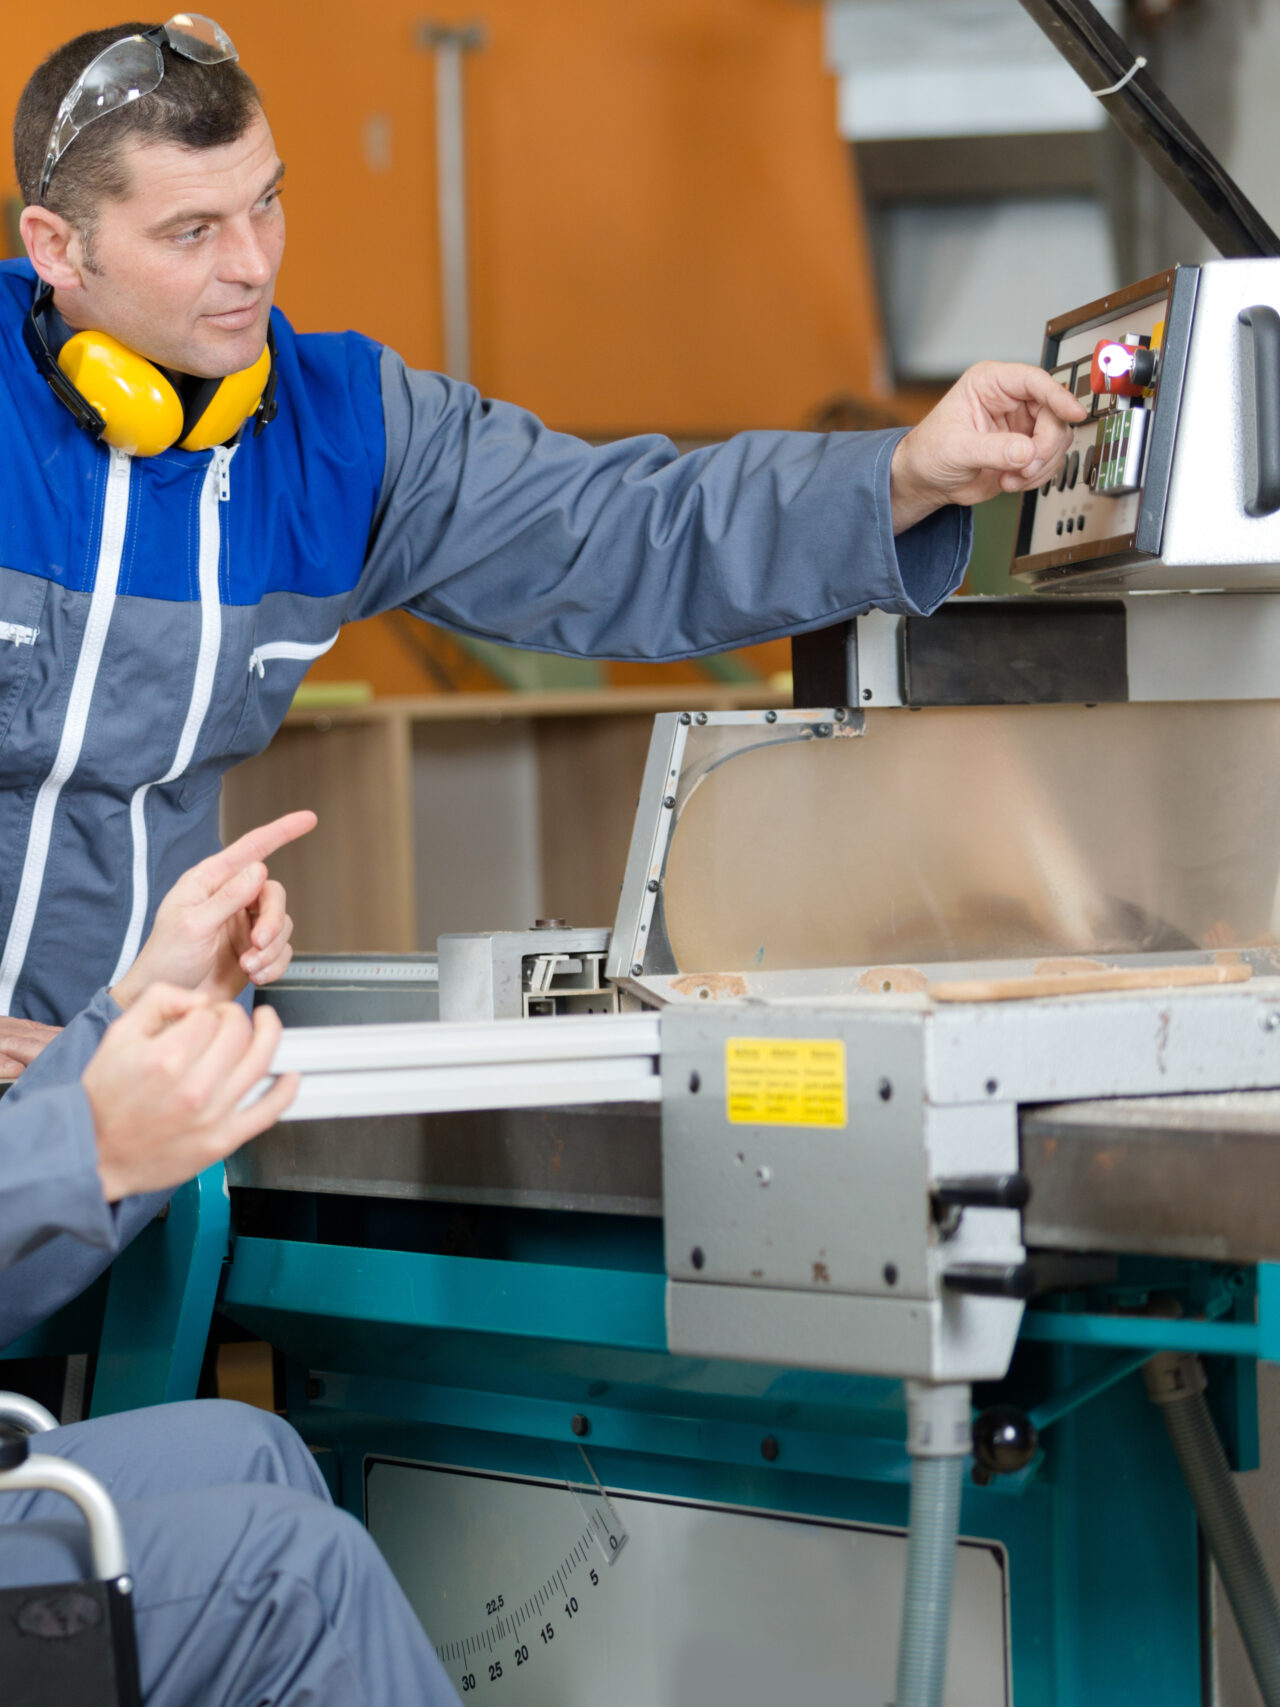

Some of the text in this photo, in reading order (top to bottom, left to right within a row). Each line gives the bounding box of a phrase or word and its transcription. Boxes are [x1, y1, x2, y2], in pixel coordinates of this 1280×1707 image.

[609, 1534, 618, 1551] 0
[589, 1568, 599, 1586] 5
[485, 1594, 505, 1616] 22,5
[565, 1596, 579, 1619] 10
[540, 1622, 554, 1645] 15
[514, 1645, 529, 1667] 20
[488, 1661, 503, 1682] 25
[461, 1673, 476, 1692] 30
